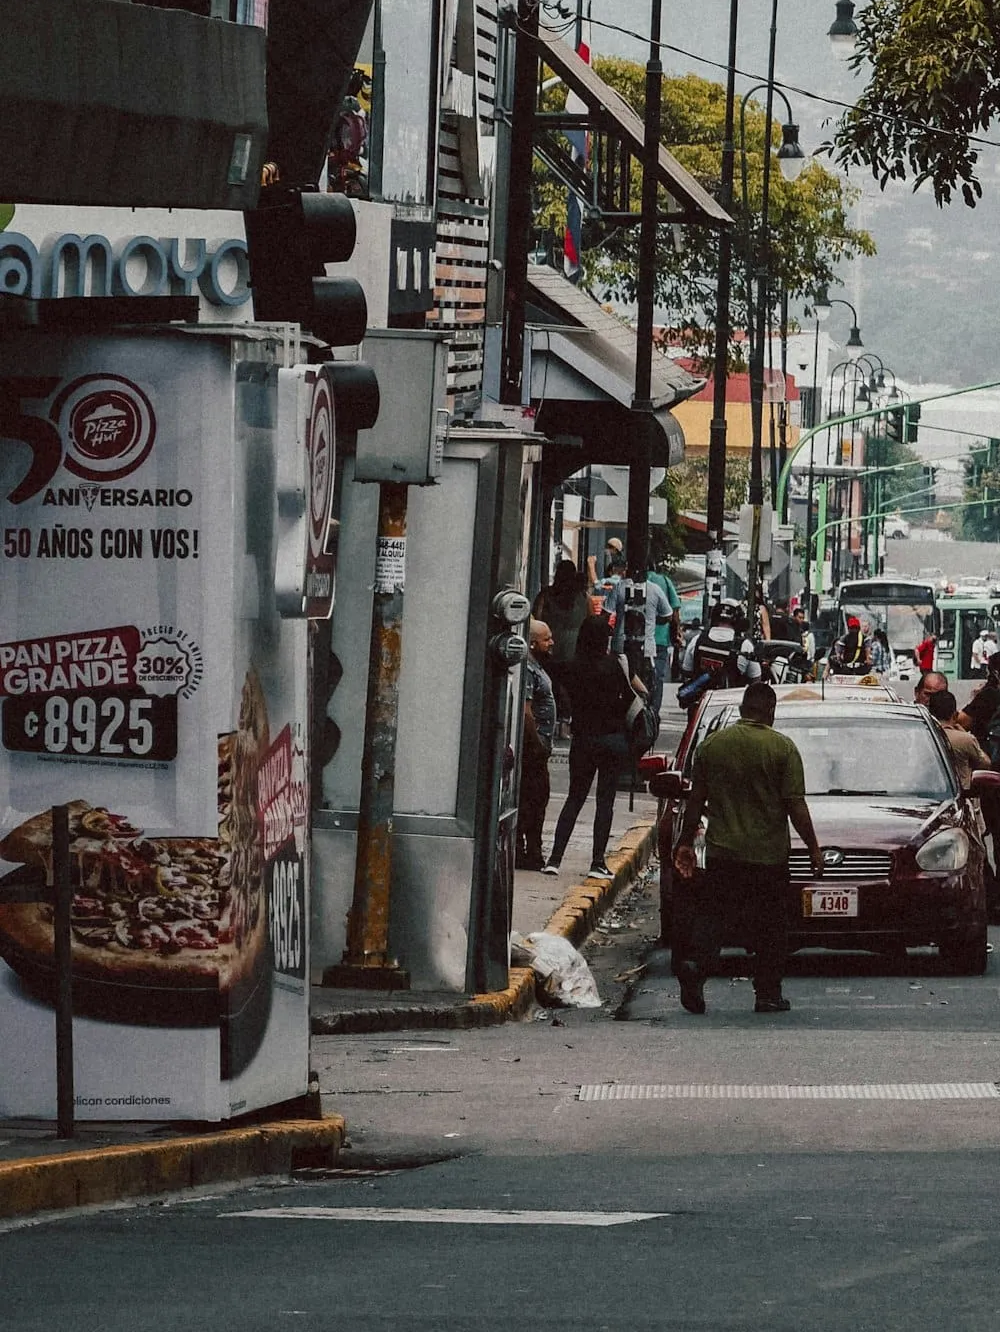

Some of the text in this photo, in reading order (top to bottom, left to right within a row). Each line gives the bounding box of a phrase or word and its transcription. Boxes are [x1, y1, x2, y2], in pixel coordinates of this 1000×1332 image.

[90, 428, 121, 448] Hut
[42, 482, 193, 512] ANIVERSARIO
[4, 524, 199, 560] 50 AÑOS CON VOS!
[0, 636, 128, 668] PAN PIZZA
[3, 658, 129, 695] GRANDE
[139, 656, 184, 675] 30%
[820, 896, 849, 911] 4348
[73, 1095, 171, 1106] lican condiciones
